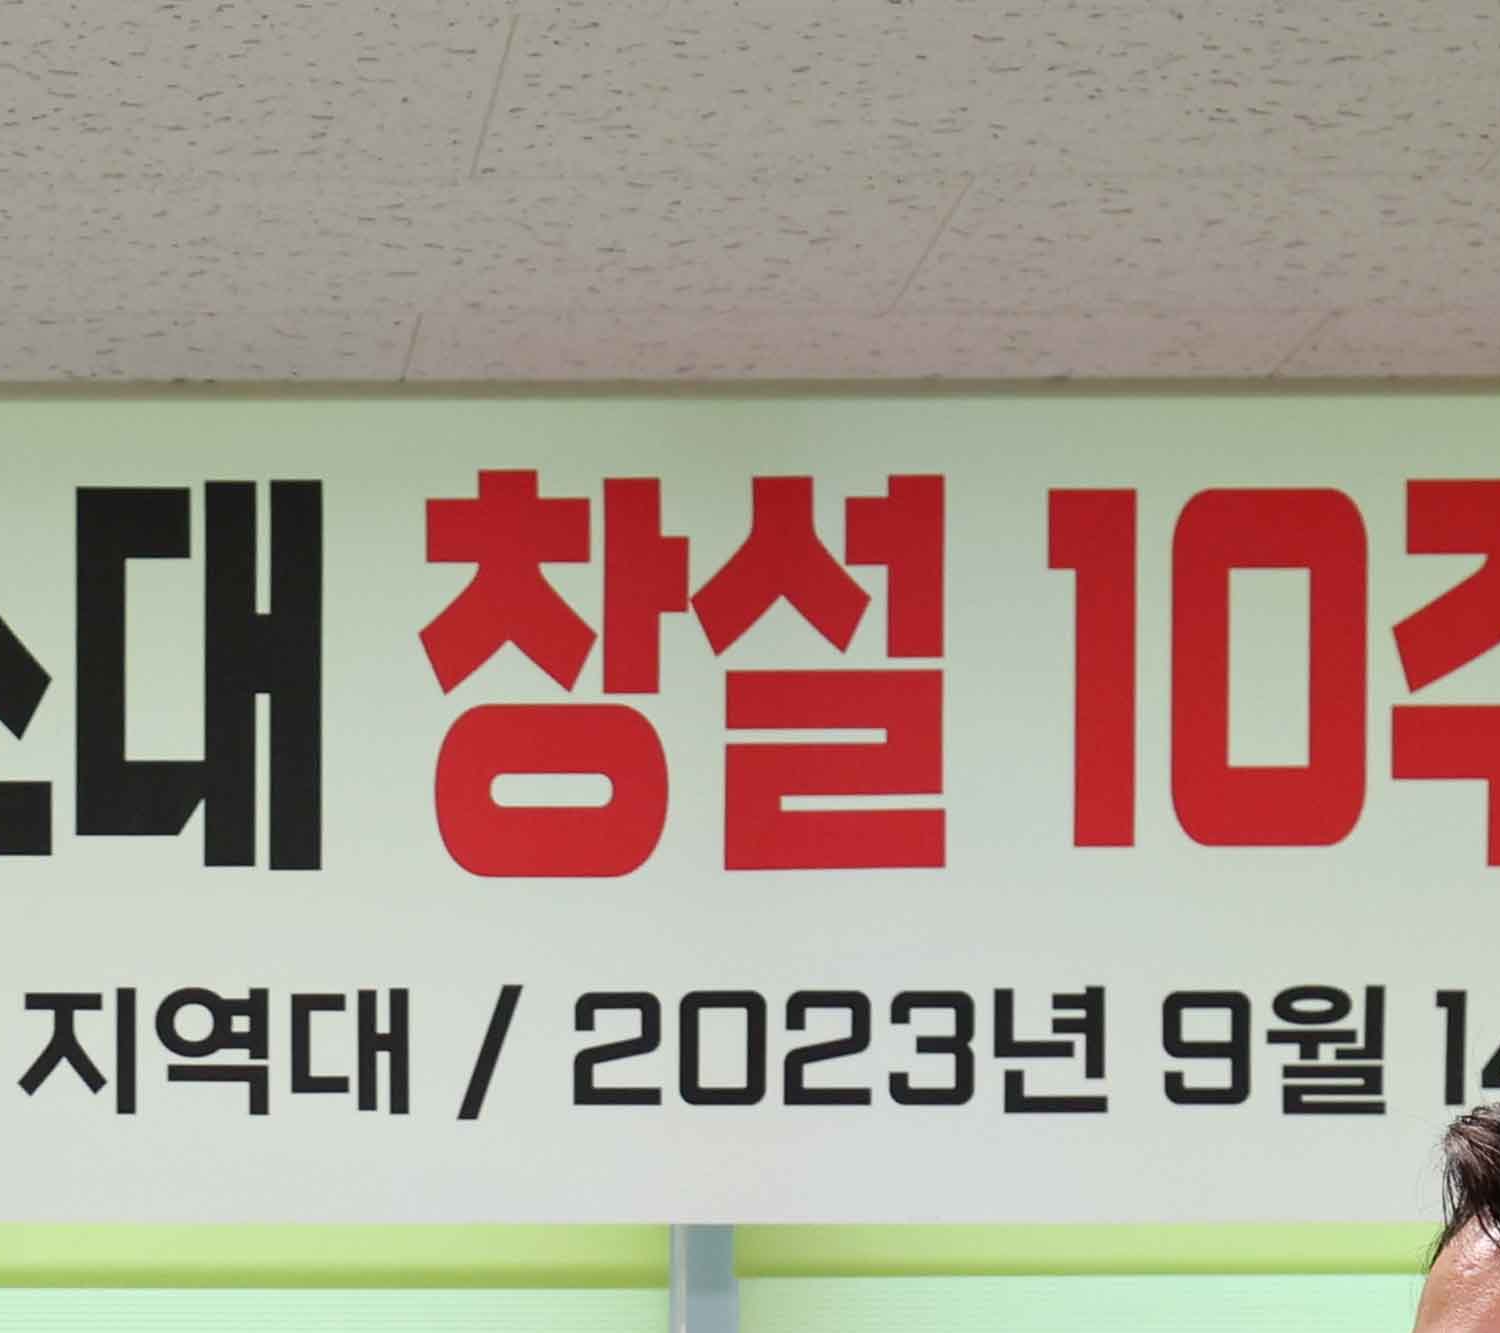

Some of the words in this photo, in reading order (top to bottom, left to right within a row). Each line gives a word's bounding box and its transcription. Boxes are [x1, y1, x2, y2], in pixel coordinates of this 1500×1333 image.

[420, 470, 948, 880] 창설
[18, 988, 410, 1117] 지역대
[458, 985, 525, 1121] /
[574, 987, 1109, 1115] 2023년
[1163, 986, 1387, 1116] 9월
